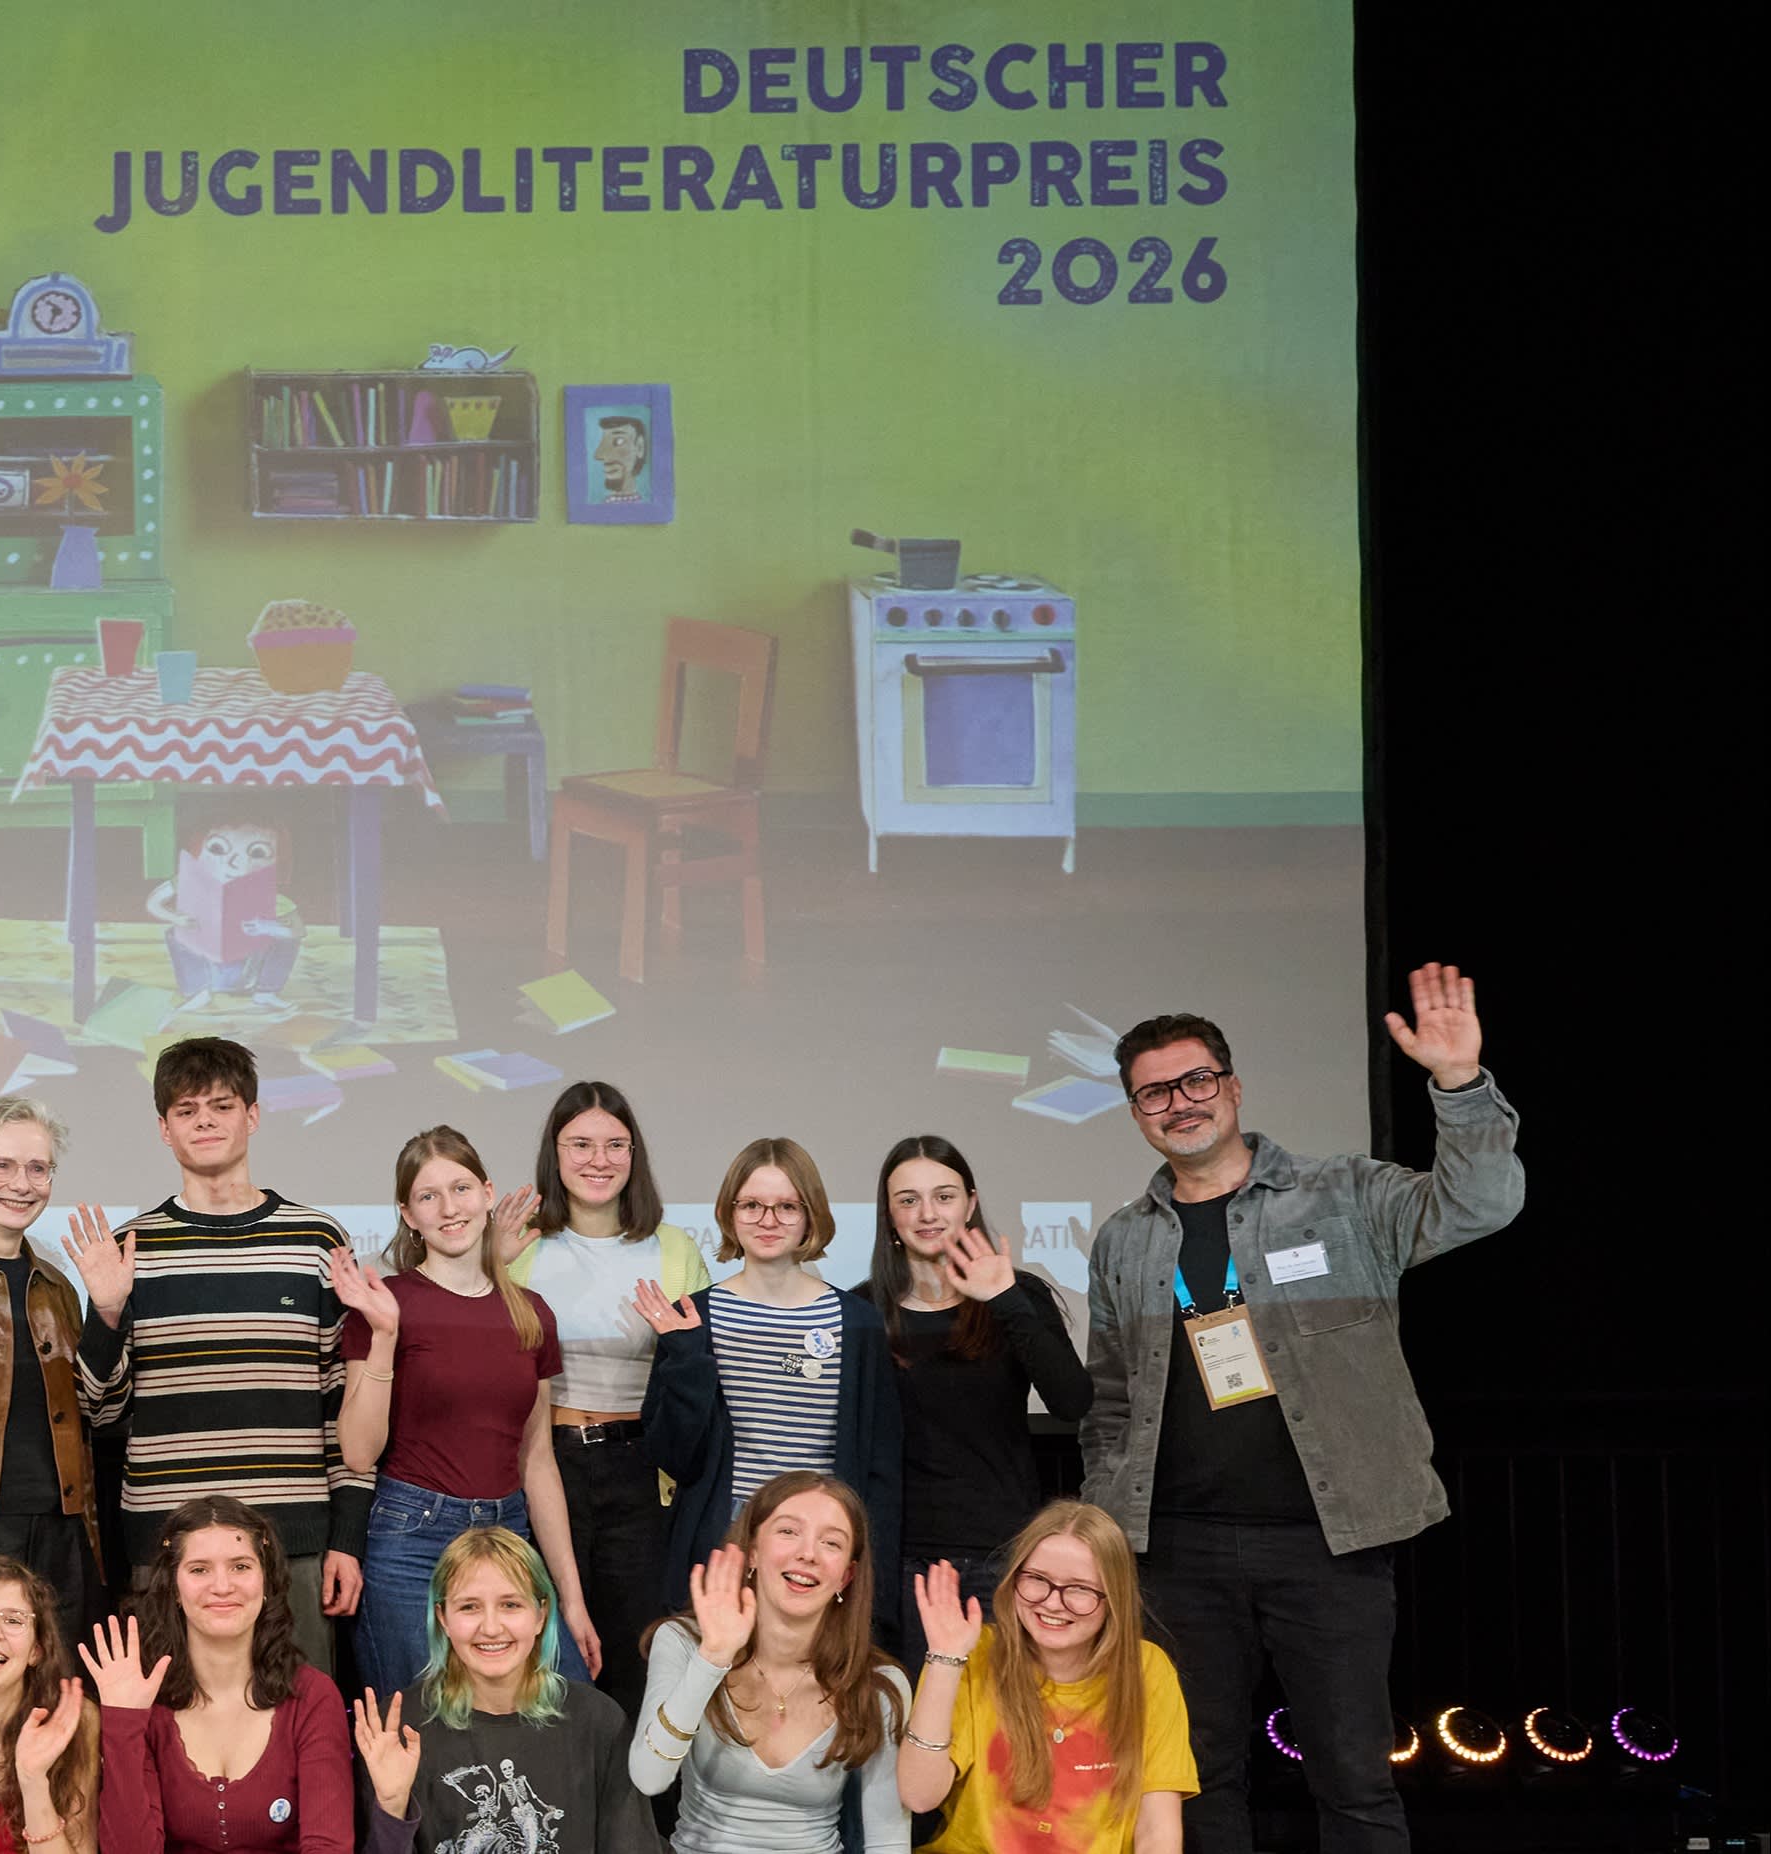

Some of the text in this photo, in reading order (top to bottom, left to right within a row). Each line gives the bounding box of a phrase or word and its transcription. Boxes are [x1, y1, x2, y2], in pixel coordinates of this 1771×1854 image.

[682, 41, 1228, 114] DEUTSCHER
[94, 137, 1228, 234] JUGENDLITERATURPREIS
[996, 236, 1228, 307] 2026
